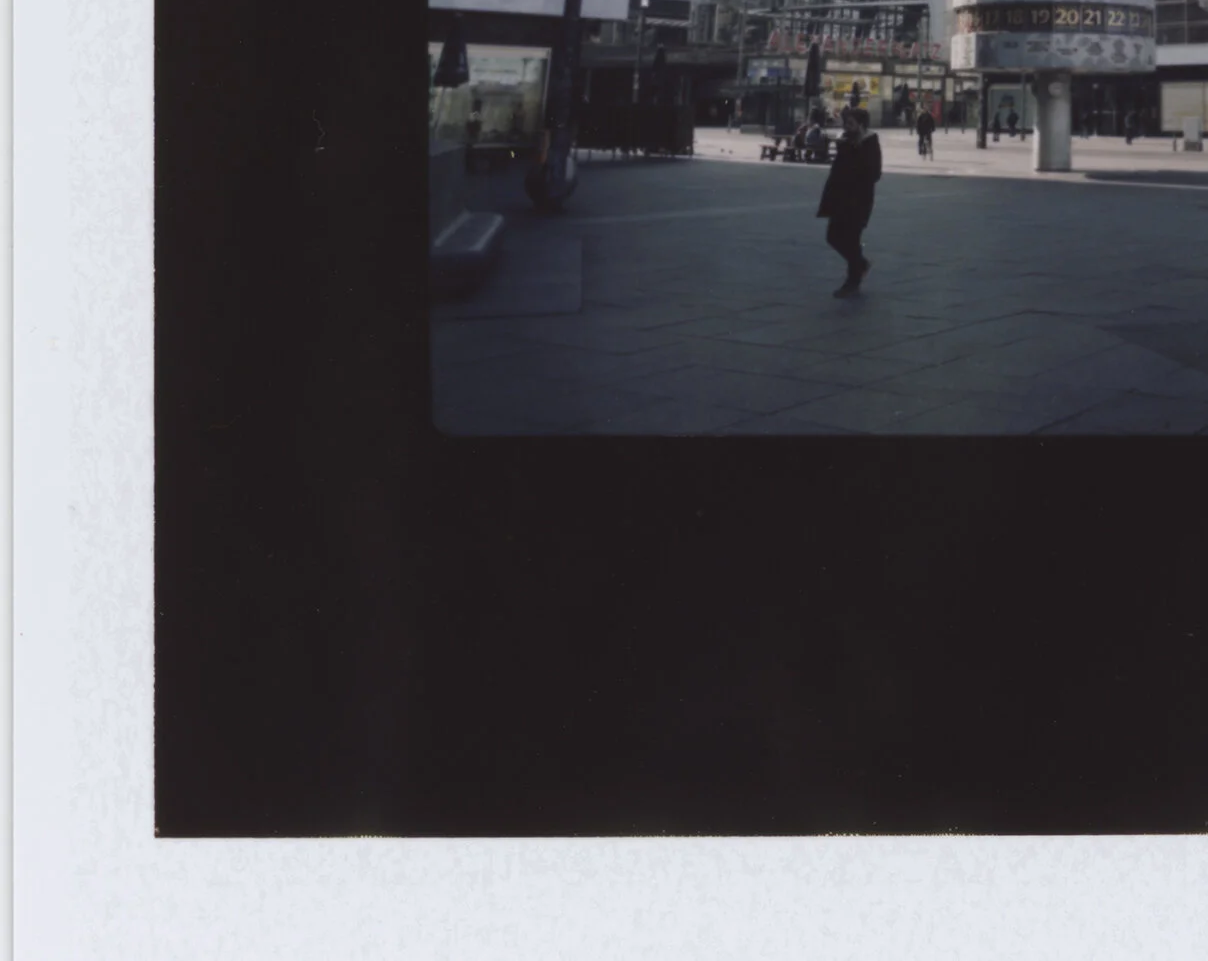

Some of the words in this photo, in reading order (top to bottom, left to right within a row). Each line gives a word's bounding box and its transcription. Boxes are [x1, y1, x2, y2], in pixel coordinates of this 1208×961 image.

[1030, 9, 1050, 25] 19
[1055, 8, 1079, 26] 20
[1083, 9, 1101, 26] 21
[1108, 10, 1126, 27] 22
